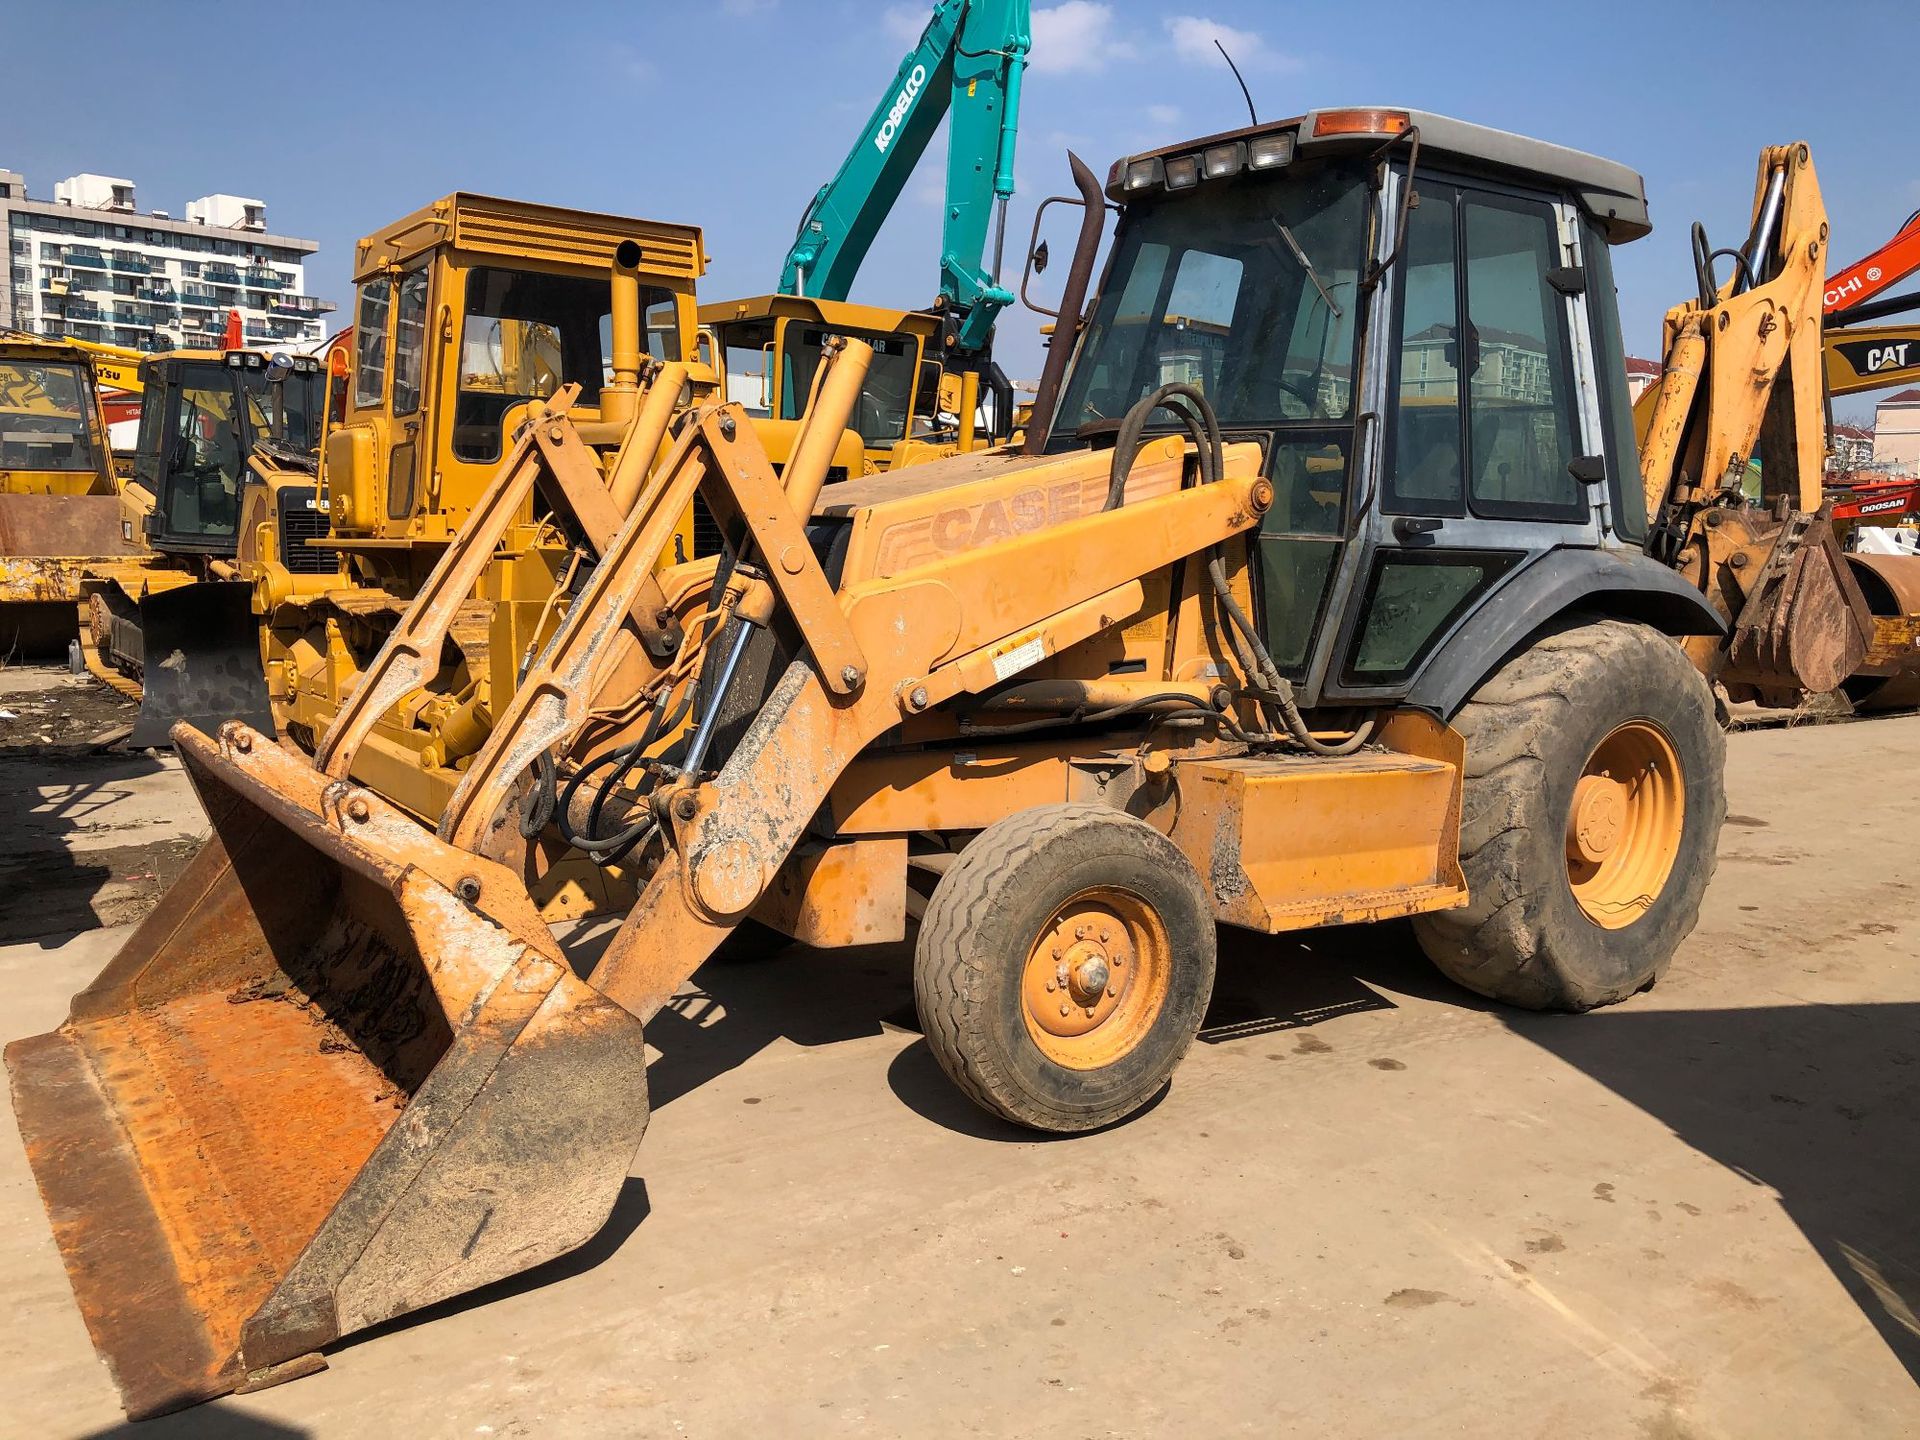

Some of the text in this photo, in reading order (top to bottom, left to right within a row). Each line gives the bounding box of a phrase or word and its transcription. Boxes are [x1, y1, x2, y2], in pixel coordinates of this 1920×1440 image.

[874, 64, 926, 154] KOBELCO
[1823, 276, 1862, 306] CHI
[1867, 343, 1909, 372] CAT
[97, 367, 121, 381] TSU
[931, 481, 1082, 551] CASE
[1860, 499, 1905, 513] DOOSAN
